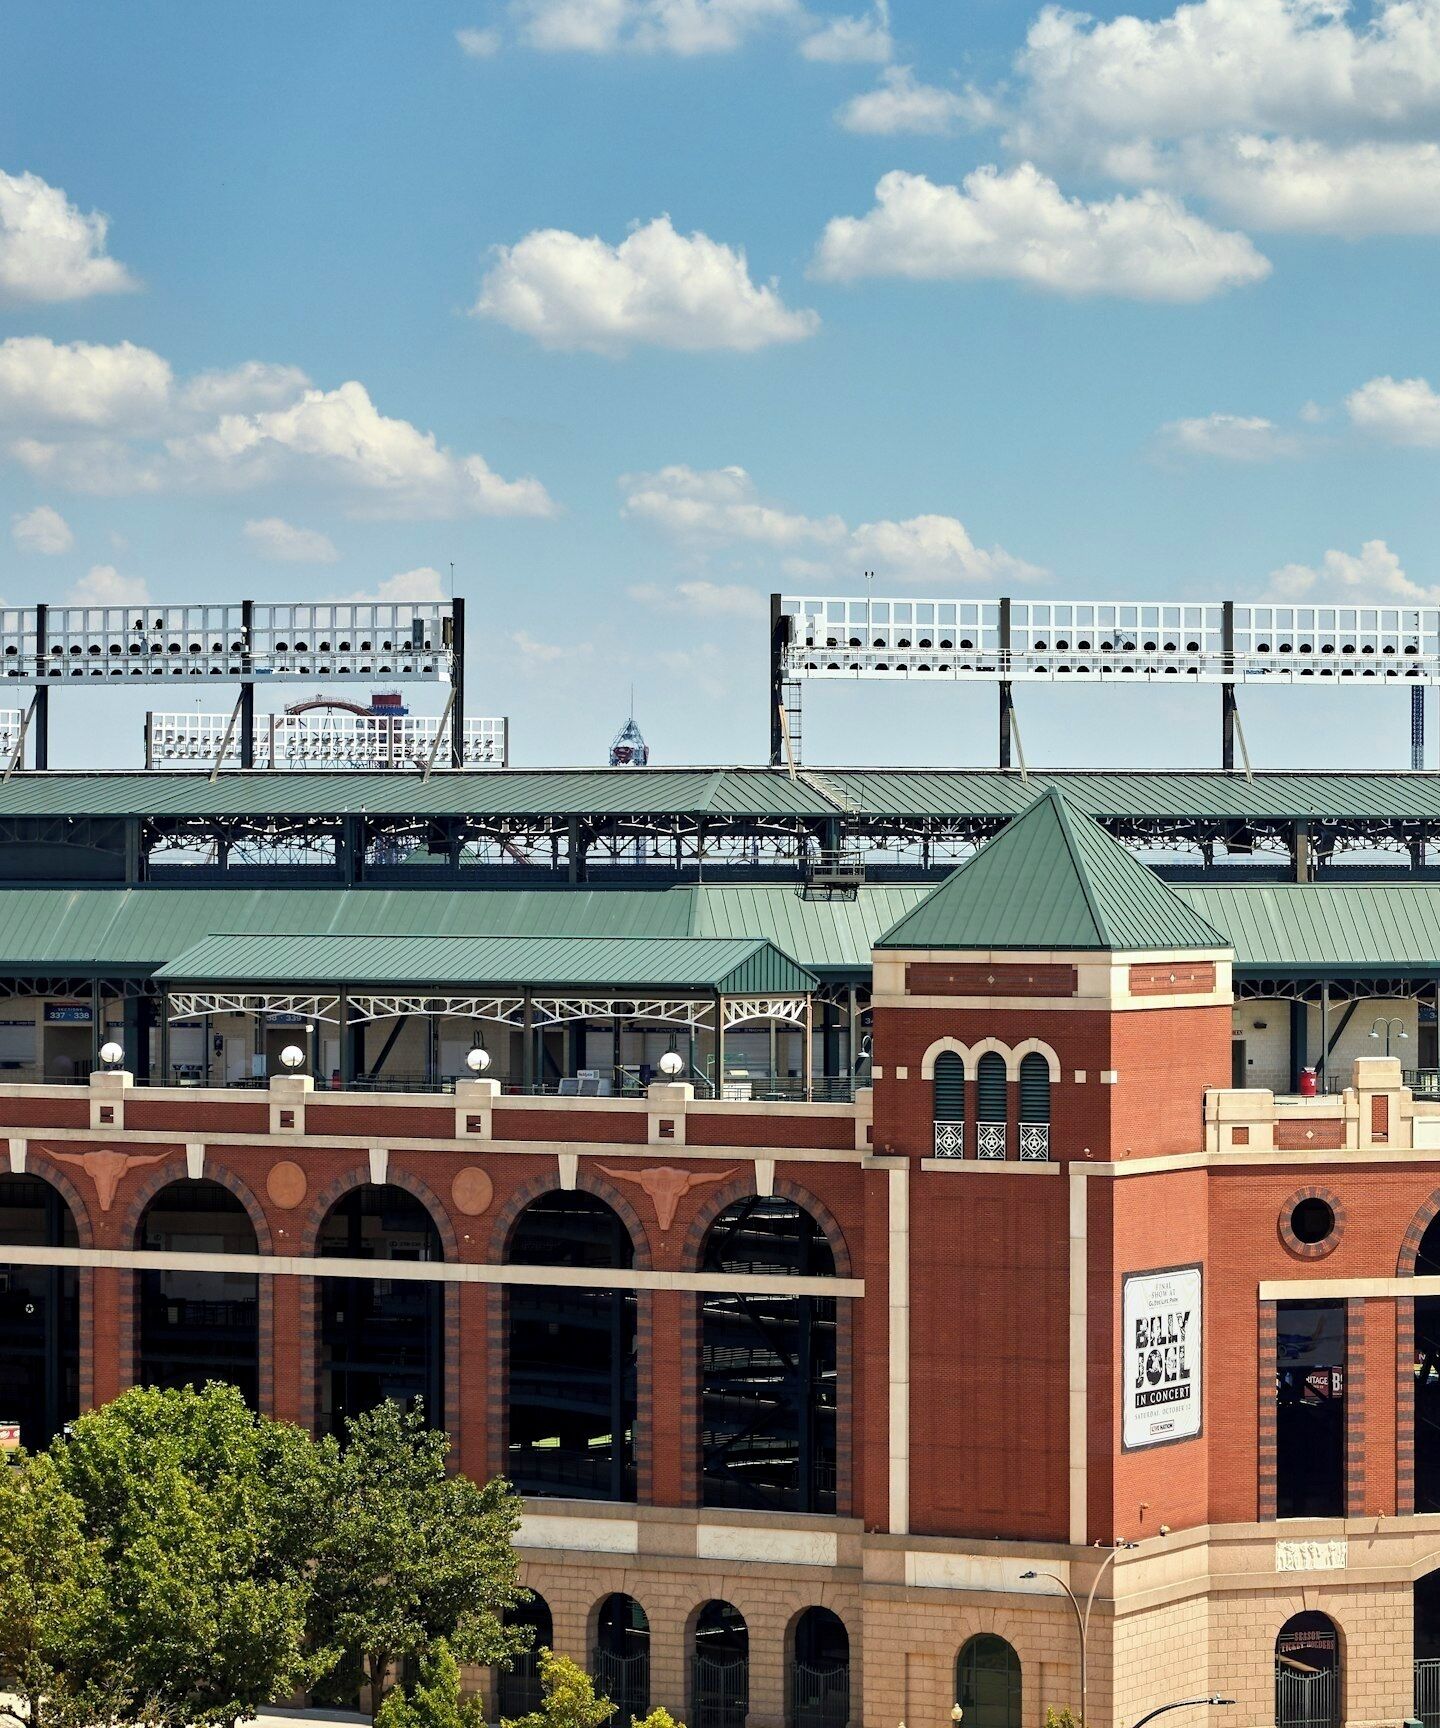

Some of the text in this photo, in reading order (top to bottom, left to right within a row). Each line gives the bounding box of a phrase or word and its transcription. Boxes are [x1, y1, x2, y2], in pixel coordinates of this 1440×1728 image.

[1136, 1311, 1191, 1349] BILLY
[1136, 1346, 1190, 1389] JOEL
[1136, 1386, 1190, 1406] IN CONCERT
[1162, 1406, 1184, 1415] OCTOBER
[1294, 1631, 1320, 1641] SEASON
